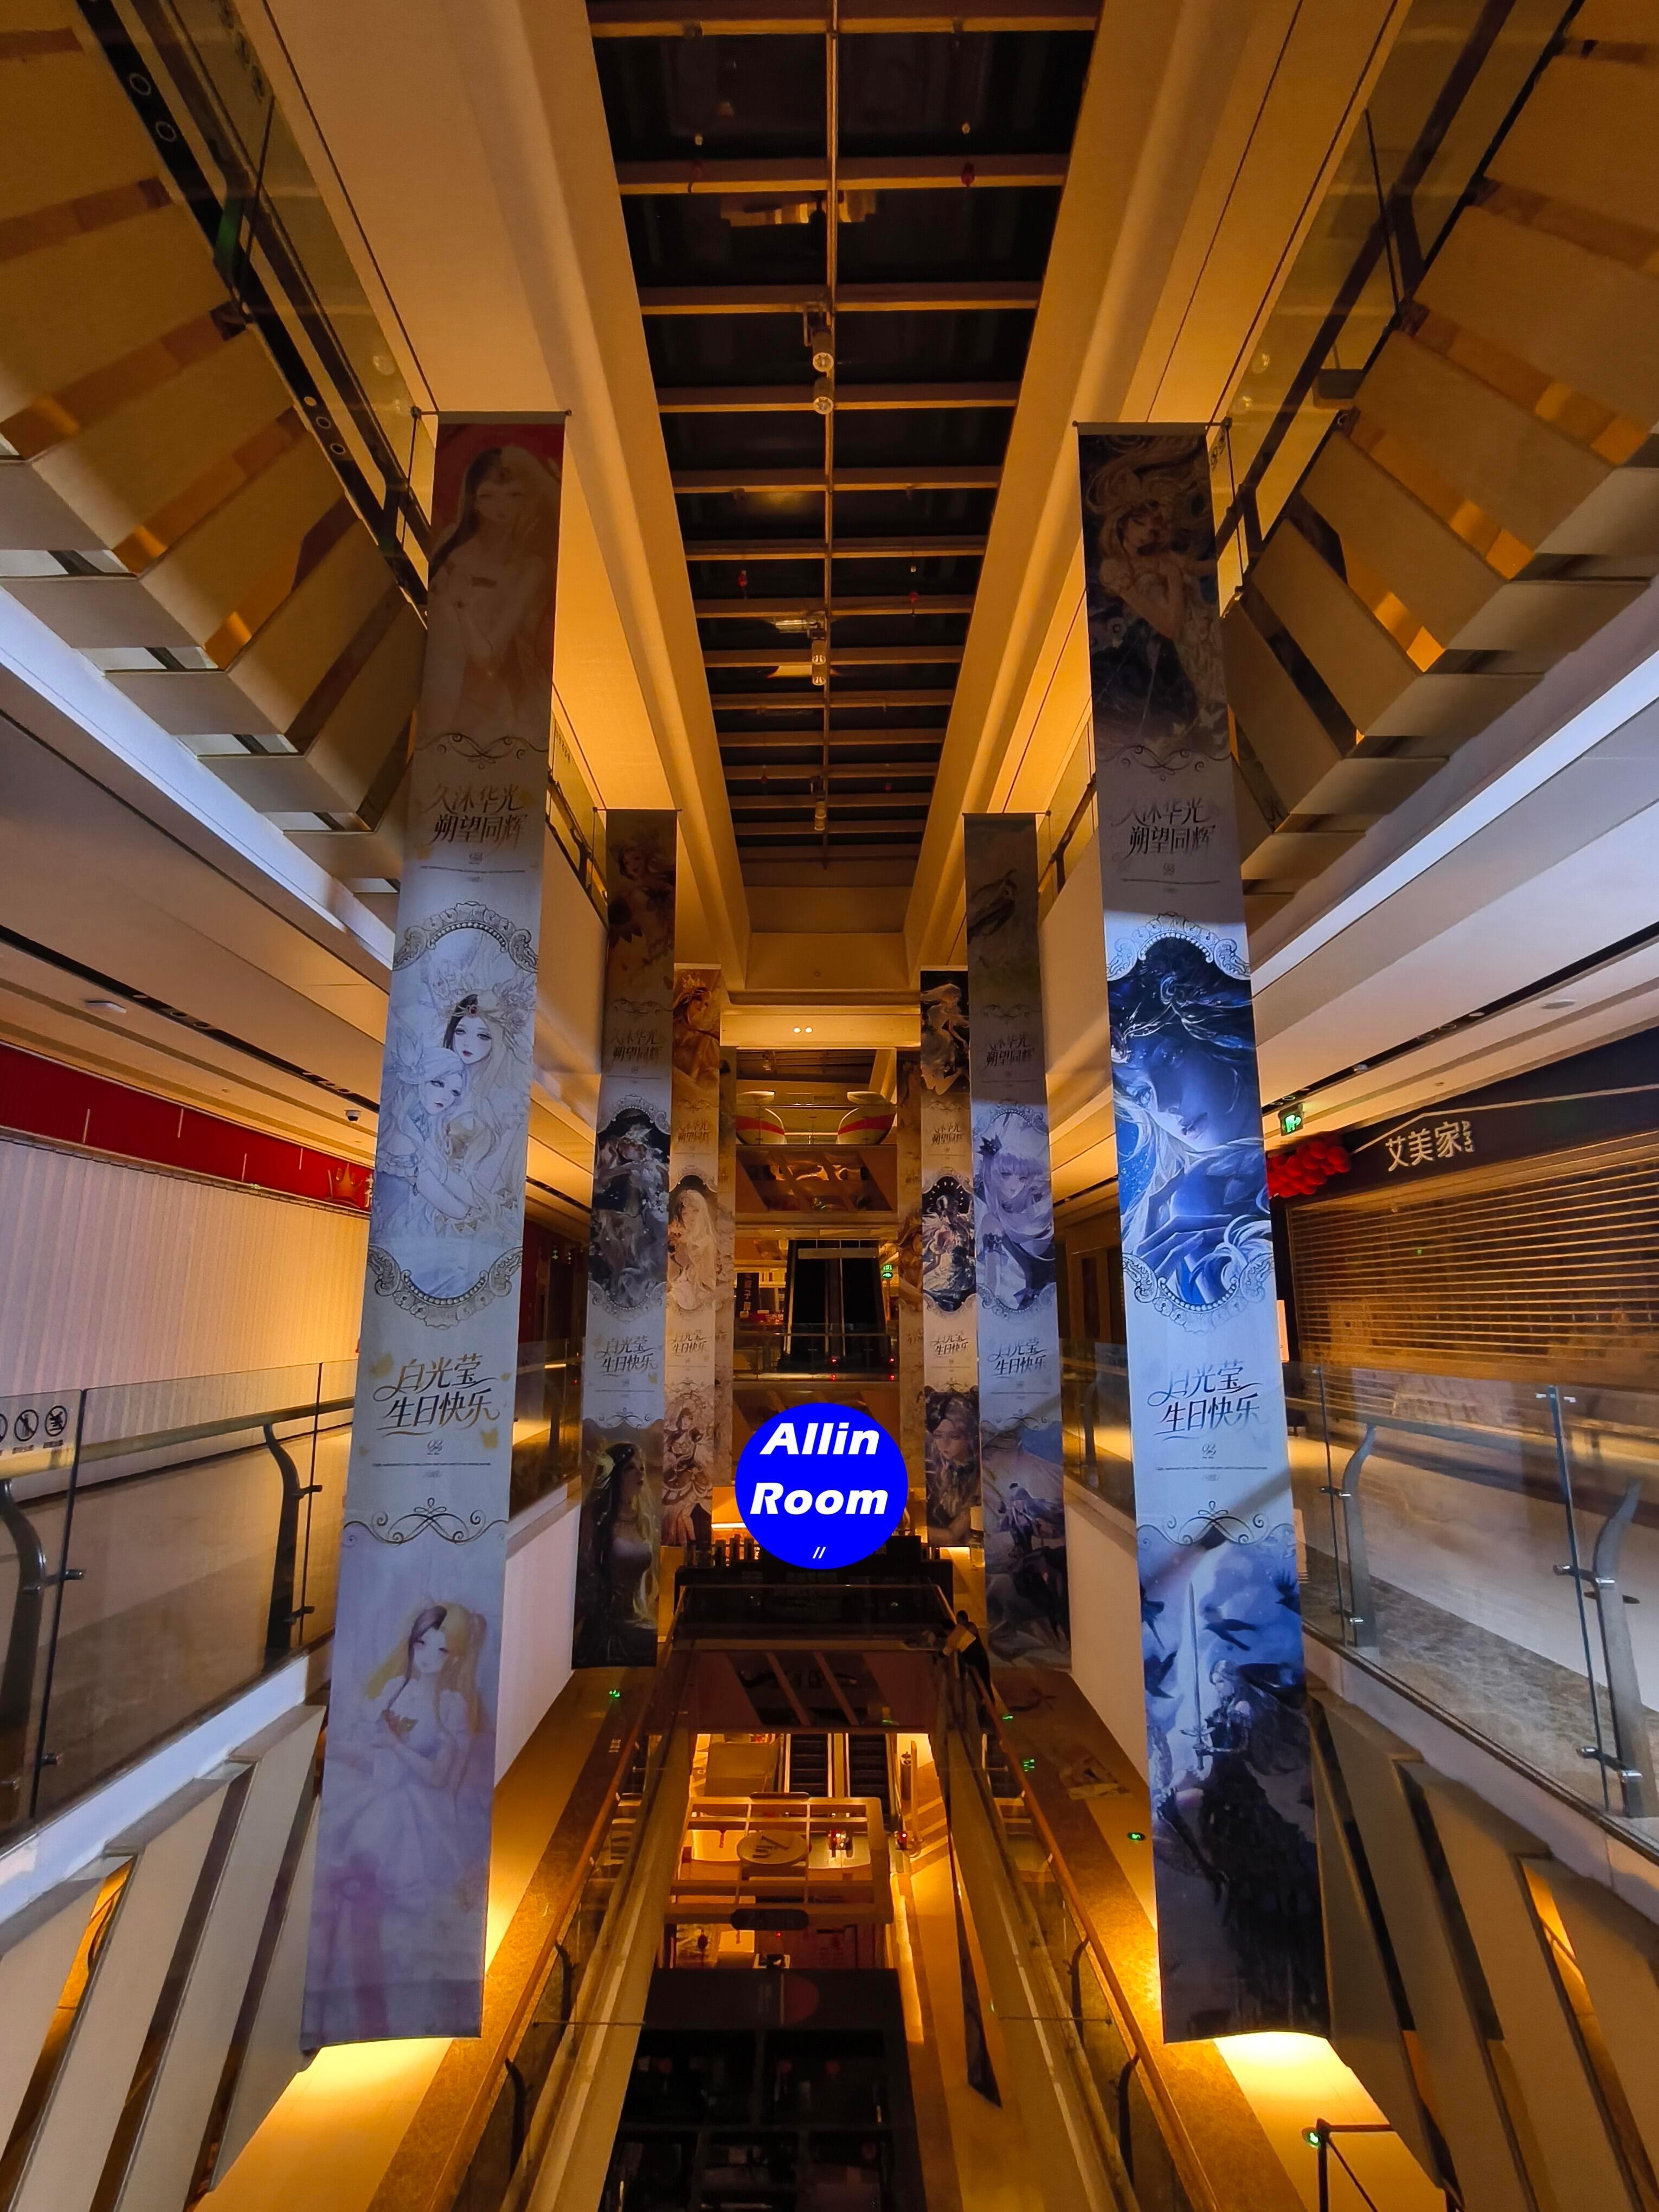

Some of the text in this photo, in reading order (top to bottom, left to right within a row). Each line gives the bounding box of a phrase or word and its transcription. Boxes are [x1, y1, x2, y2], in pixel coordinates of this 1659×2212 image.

[1384, 1120, 1463, 1172] 艾美家
[597, 1353, 658, 1377] 生日快乐
[992, 1354, 1047, 1379] 生日快乐
[376, 1387, 500, 1437] 生日快乐
[1154, 1392, 1269, 1442] 生日快乐
